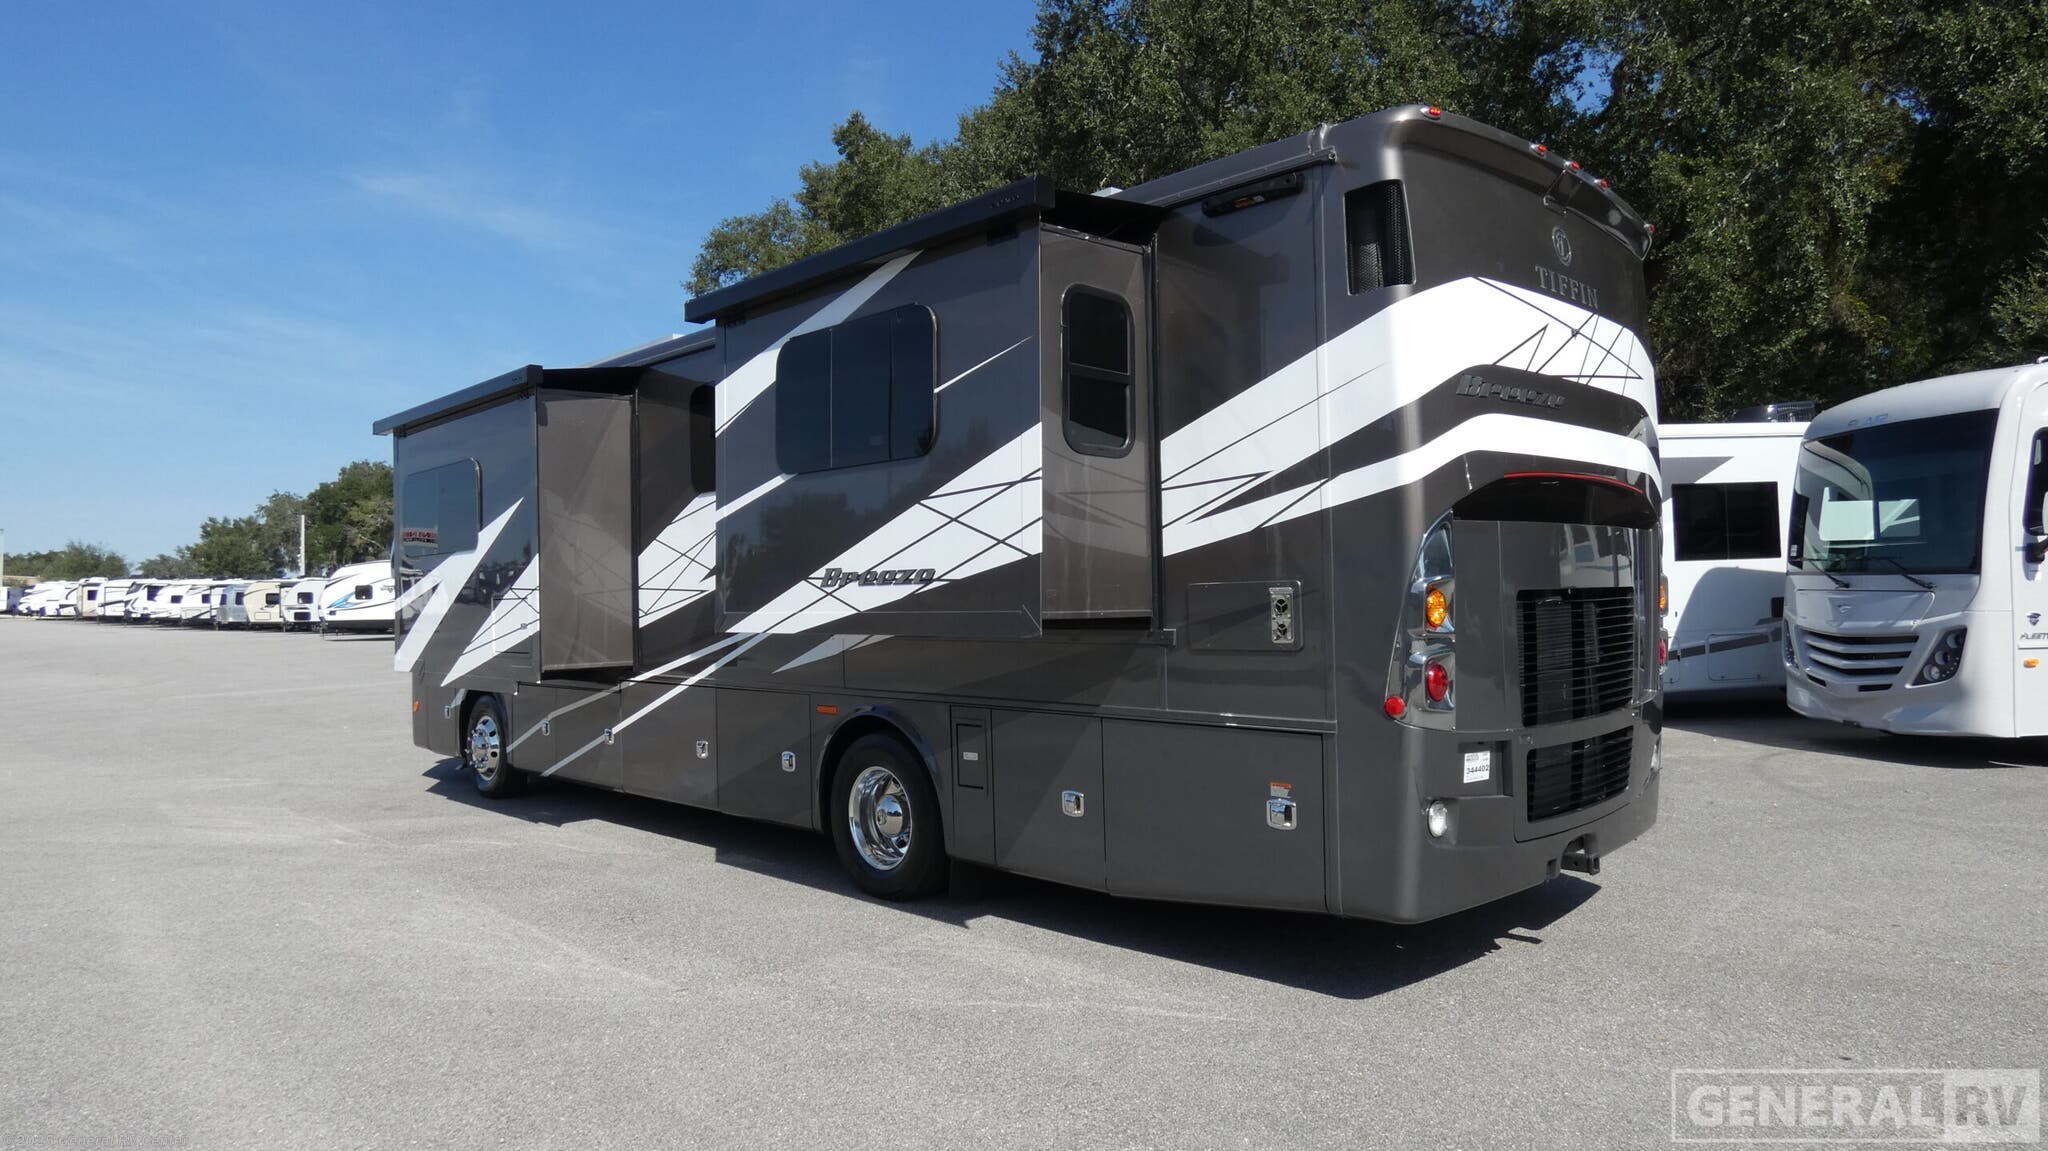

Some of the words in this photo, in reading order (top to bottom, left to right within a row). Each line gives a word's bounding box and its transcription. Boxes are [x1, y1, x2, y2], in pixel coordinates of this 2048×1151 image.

[1535, 265, 1599, 310] TIFFIN
[1456, 374, 1566, 409] Breeze
[820, 567, 936, 588] Breeze
